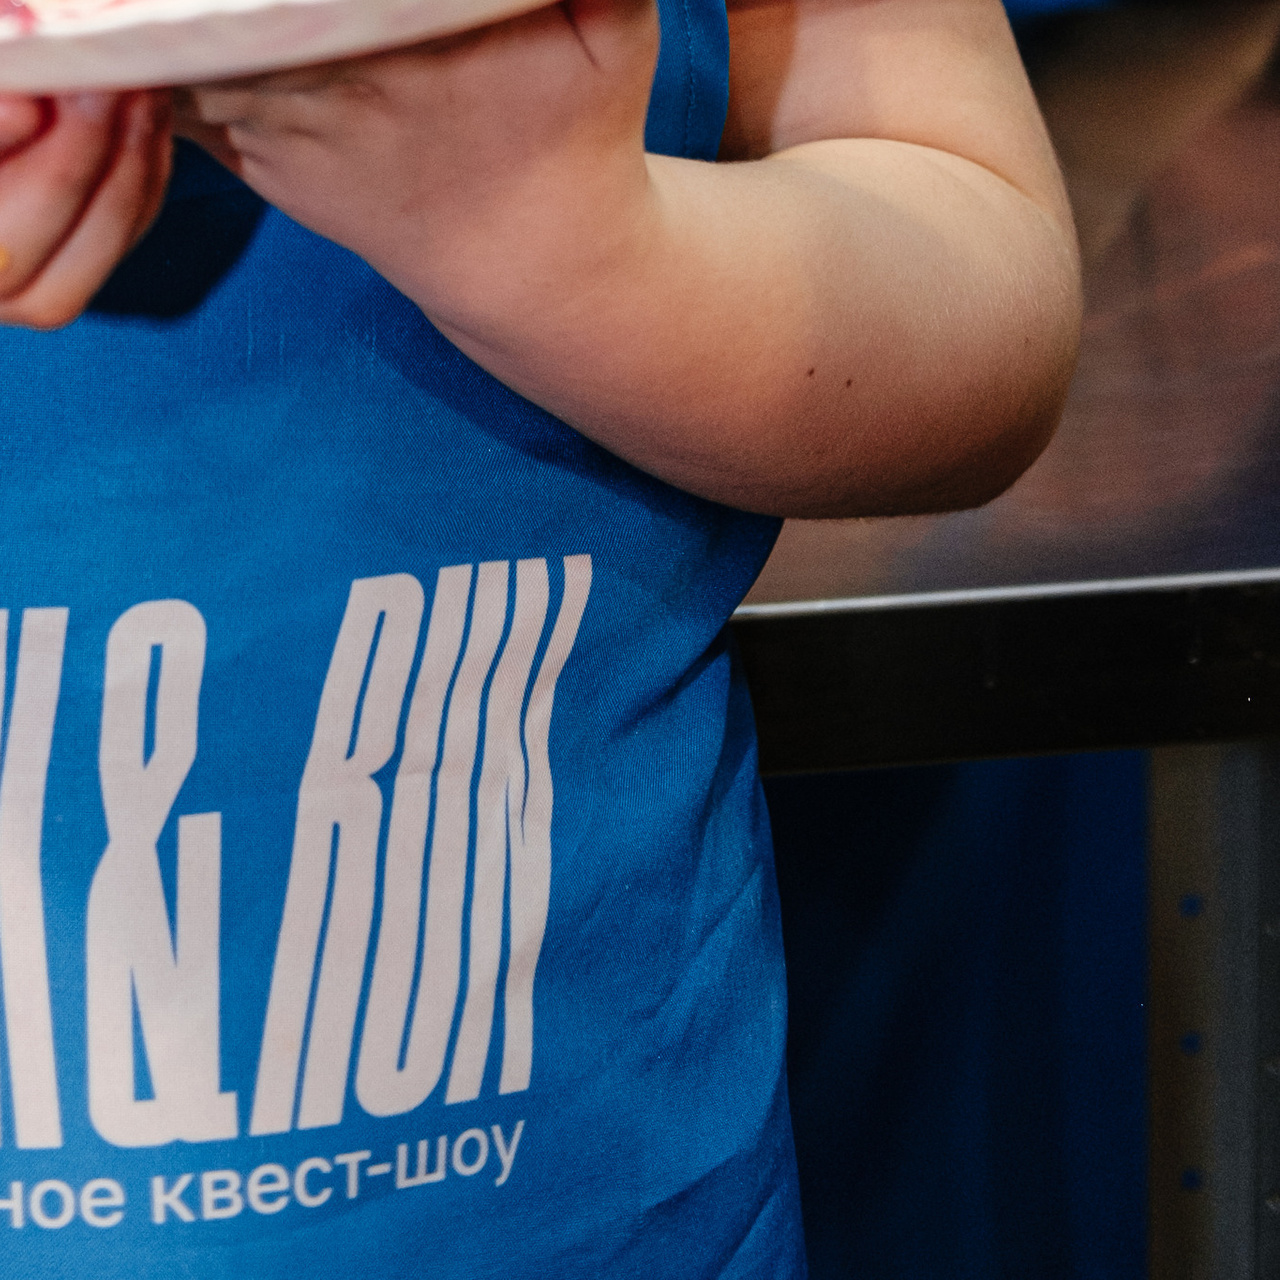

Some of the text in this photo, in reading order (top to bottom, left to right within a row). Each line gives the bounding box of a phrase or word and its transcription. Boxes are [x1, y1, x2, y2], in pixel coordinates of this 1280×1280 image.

[86, 599, 238, 1147] &
[250, 553, 593, 1137] RUN
[151, 1120, 526, 1225] квест-шоу
